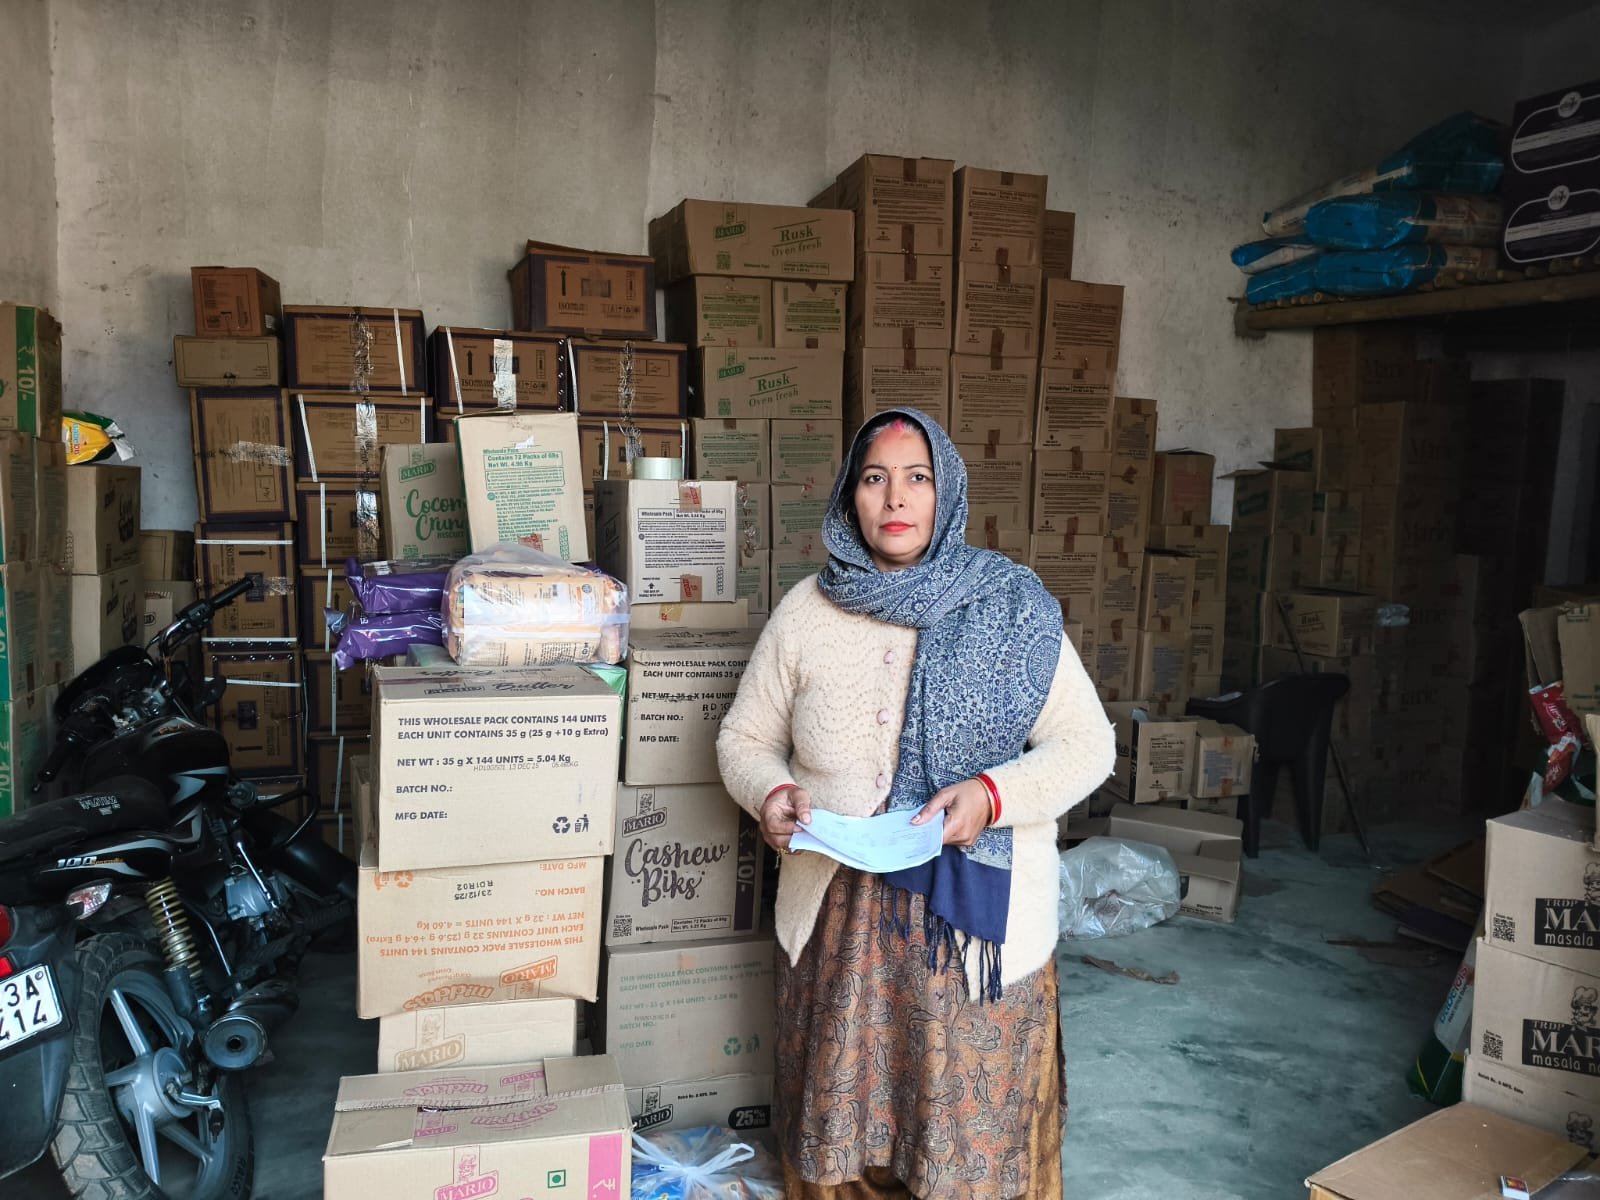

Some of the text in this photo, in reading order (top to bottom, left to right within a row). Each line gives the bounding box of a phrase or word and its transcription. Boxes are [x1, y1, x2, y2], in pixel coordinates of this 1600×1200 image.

[781, 225, 814, 241] Rusk
[772, 240, 822, 256] Oven fresh
[18, 366, 35, 400] 10/-
[758, 373, 789, 391] Rusk
[748, 388, 799, 407] Oven fresh
[402, 463, 433, 480] MARIO
[416, 515, 466, 540] Crun
[424, 717, 481, 725] WHOLESALE
[511, 716, 558, 724] CONTAINS
[398, 731, 424, 739] EACH
[454, 730, 503, 738] CONTAINS
[529, 729, 543, 738] (25
[584, 727, 608, 736] Extra)
[397, 758, 416, 766] NET
[419, 758, 434, 766] WT
[457, 759, 463, 767] g
[558, 754, 570, 763] Kg
[396, 785, 427, 794] BATCH
[624, 812, 666, 834] MARIO
[58, 856, 97, 868] 100
[625, 839, 730, 878] Cashew
[540, 862, 586, 872] MFG DATE:
[558, 887, 585, 895] BATCH
[642, 868, 702, 907] Biks
[454, 890, 492, 900] 23/12/25
[551, 913, 566, 921] WT
[568, 912, 584, 920] NET
[417, 921, 429, 930] Kg
[433, 921, 452, 929] 4.60
[465, 919, 493, 928] UNITS
[562, 924, 583, 932] EACH
[487, 928, 534, 938] CONTAINS
[537, 926, 559, 935] UNIT
[366, 935, 392, 944] Extra)
[439, 932, 461, 942] (25.6
[1545, 932, 1594, 947] masala
[509, 938, 561, 949] WHOLESALE
[432, 946, 479, 955] CONTAINS
[502, 961, 554, 984] MARIO
[696, 965, 728, 974] CONTAINS
[658, 979, 691, 988] CONTAINS
[401, 1040, 461, 1072] MARIO
[1532, 1053, 1580, 1071] masala
[736, 1111, 753, 1126] 25
